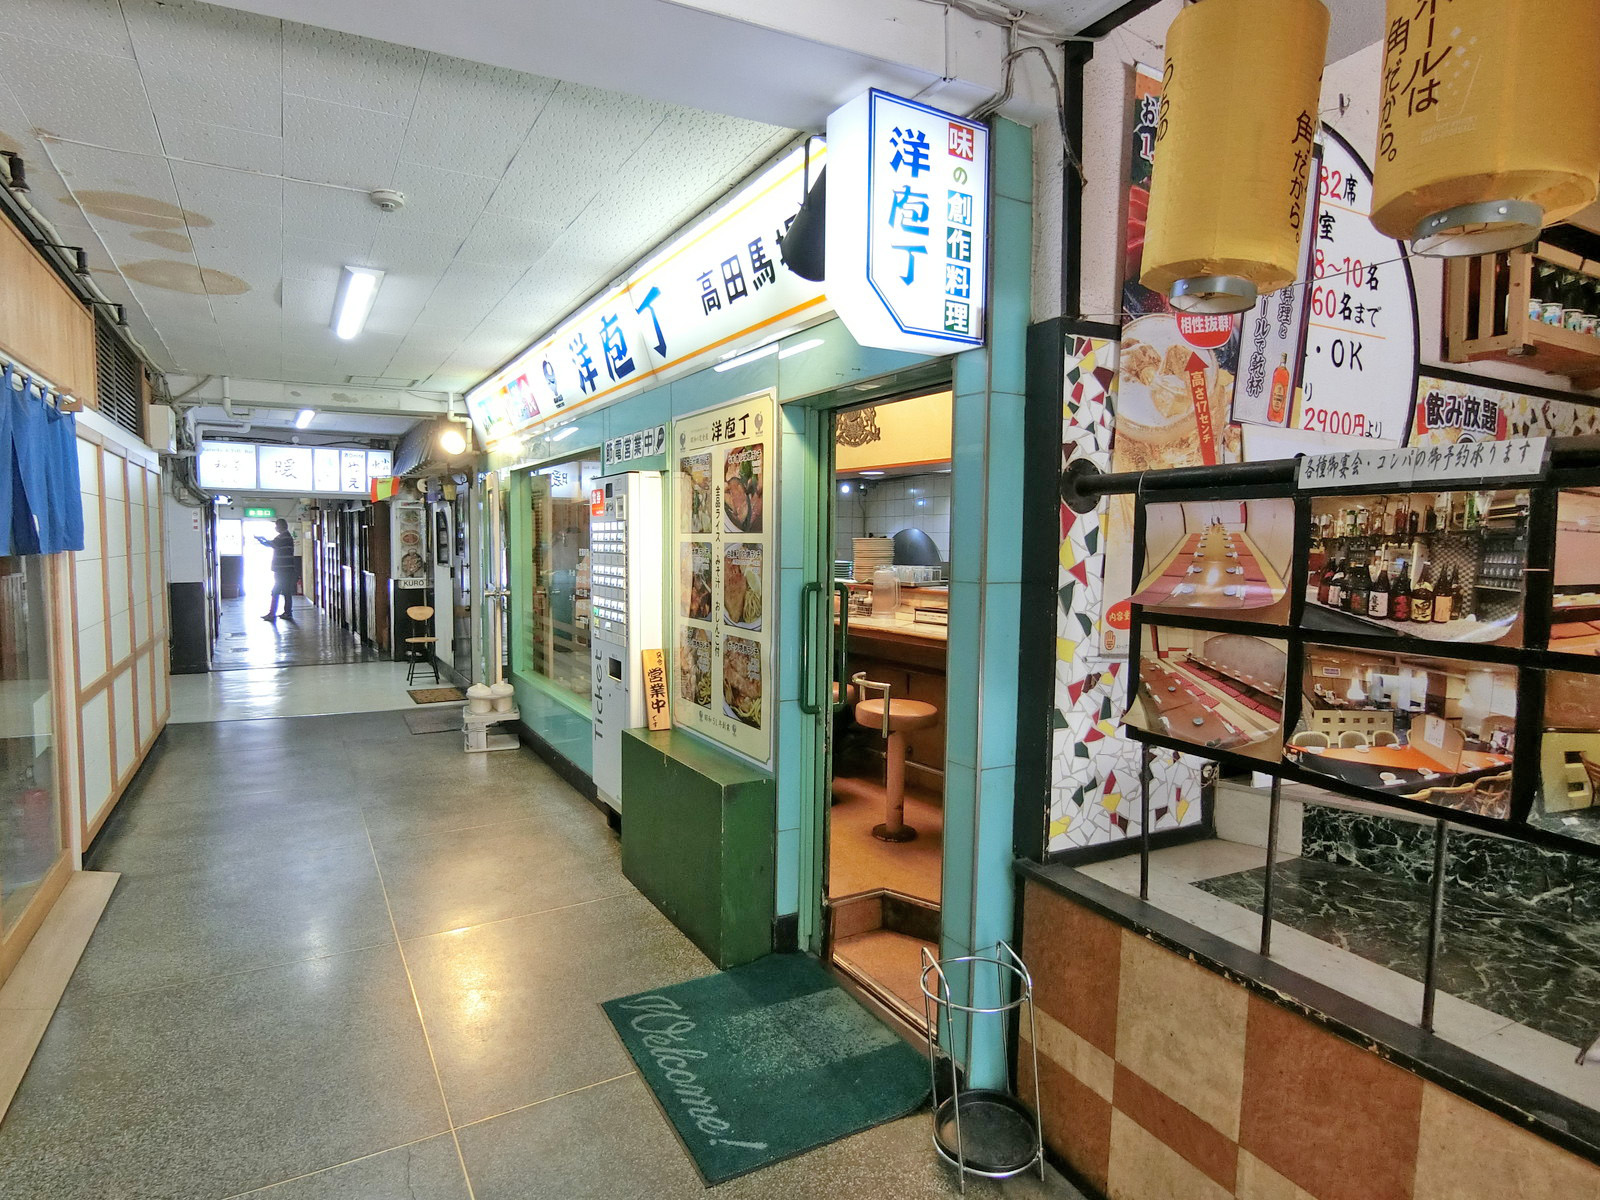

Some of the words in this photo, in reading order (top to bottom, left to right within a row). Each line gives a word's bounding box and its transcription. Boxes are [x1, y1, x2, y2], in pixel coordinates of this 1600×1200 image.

[889, 126, 931, 286] 洋庖丁
[1319, 166, 1358, 206] 82席
[945, 122, 974, 334] 味の創作料理
[568, 286, 668, 396] 洋庖丁
[1311, 285, 1382, 328] 60名まで
[1246, 291, 1274, 398] ールで乾杯
[711, 413, 750, 442] 洋庖丁
[1190, 371, 1212, 444] 高さ17センチ
[1303, 406, 1383, 439] 2900円より
[1425, 392, 1498, 433] 飲み放題
[619, 995, 769, 1149] Welcome!
